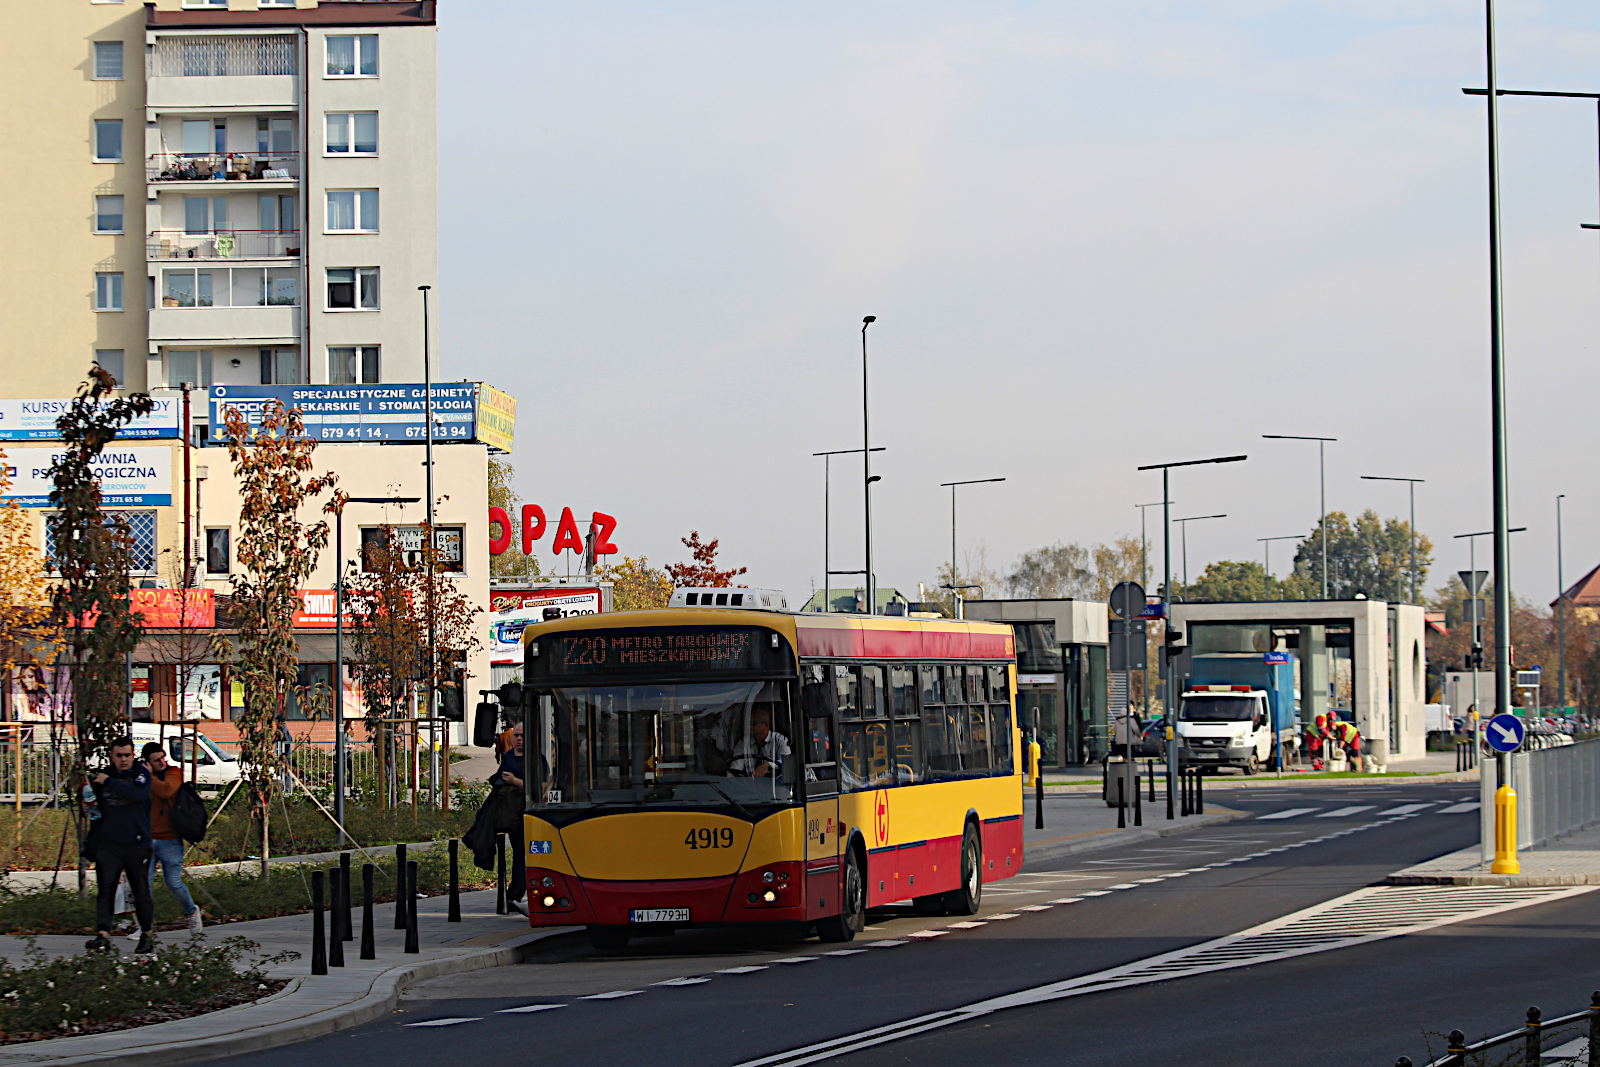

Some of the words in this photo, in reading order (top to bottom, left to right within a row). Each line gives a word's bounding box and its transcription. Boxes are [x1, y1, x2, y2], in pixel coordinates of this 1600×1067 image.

[292, 389, 406, 399] SPECJALISTYCZNE
[411, 388, 473, 398] GABINETY
[22, 401, 68, 413] KURSY
[368, 402, 373, 411] I
[379, 400, 473, 411] STOMATOLOGIA
[321, 428, 344, 438] 679
[346, 428, 361, 438] 41
[405, 427, 428, 437] 678
[432, 426, 448, 437] 13
[450, 426, 466, 437] 94
[303, 591, 335, 614] ŚWIAT
[611, 636, 663, 649] METRO
[666, 632, 749, 648] TARGÓWEK
[620, 648, 742, 663] MIESZKANIOWY
[684, 827, 735, 850] 4919
[654, 909, 689, 921] 7793H
